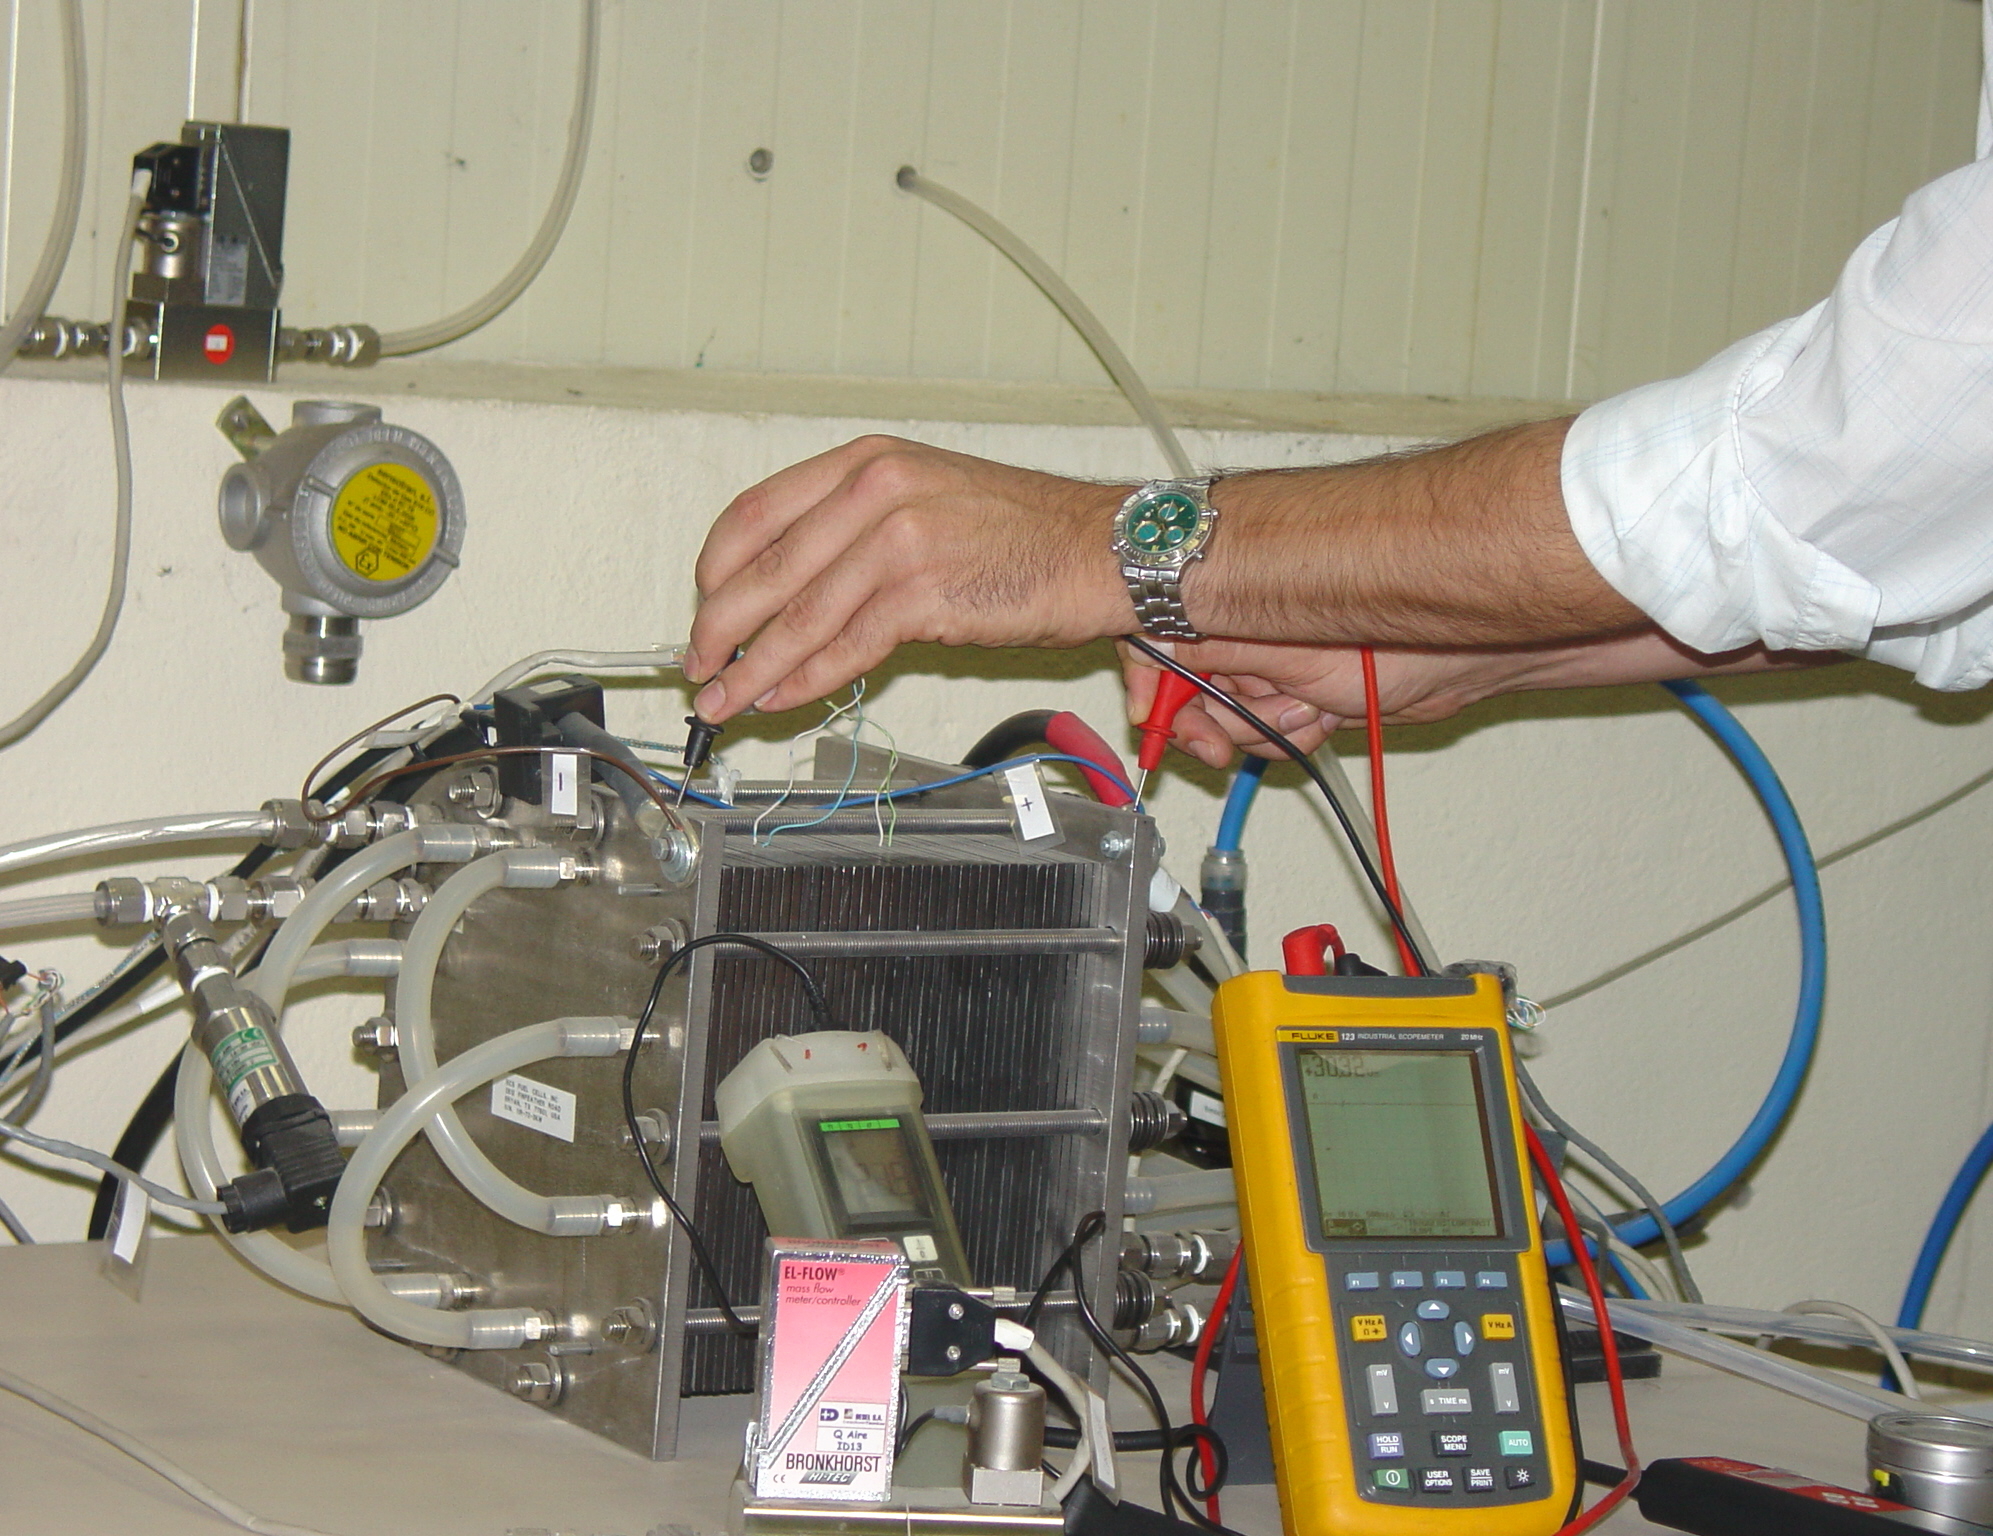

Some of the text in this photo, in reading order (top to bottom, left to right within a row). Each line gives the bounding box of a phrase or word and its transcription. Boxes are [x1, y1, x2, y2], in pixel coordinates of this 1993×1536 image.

[1291, 1032, 1335, 1040] FLUKE
[1341, 1032, 1355, 1041] 123
[1357, 1032, 1397, 1040] INDUSTRIAL
[1398, 1032, 1444, 1040] SCOPEMETER
[814, 1282, 835, 1293] flow
[785, 1295, 862, 1306] meter/controller
[1506, 1400, 1512, 1408] V
[833, 1429, 868, 1440] Q Aire
[1376, 1435, 1399, 1443] HOLD
[1440, 1435, 1468, 1443] SCOPE
[837, 1441, 862, 1451] ID13
[1444, 1443, 1467, 1451] MENU
[1508, 1439, 1529, 1447] AUTO
[786, 1453, 882, 1473] BRONKHORST
[1470, 1468, 1491, 1476] SAVE
[1424, 1478, 1453, 1487] OPTIONS
[1470, 1478, 1493, 1487] PRINT
